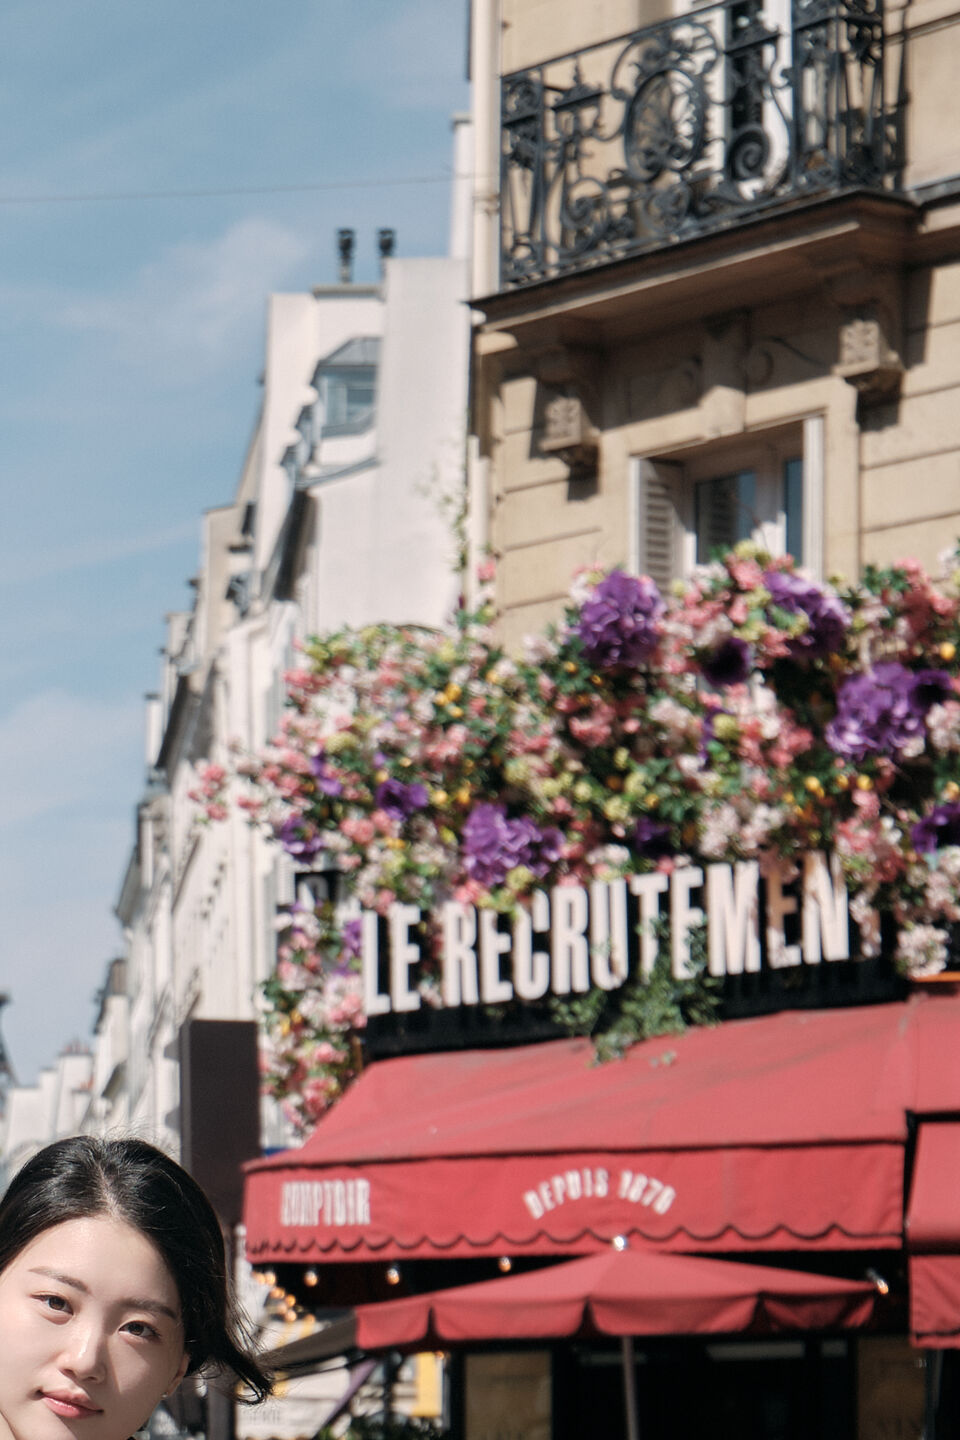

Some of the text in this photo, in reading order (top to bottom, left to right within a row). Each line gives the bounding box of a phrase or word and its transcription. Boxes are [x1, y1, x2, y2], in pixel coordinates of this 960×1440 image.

[363, 902, 421, 1016] LE
[281, 1178, 371, 1227] COMPTOIR
[523, 1167, 677, 1219] DEPUIS 1870
